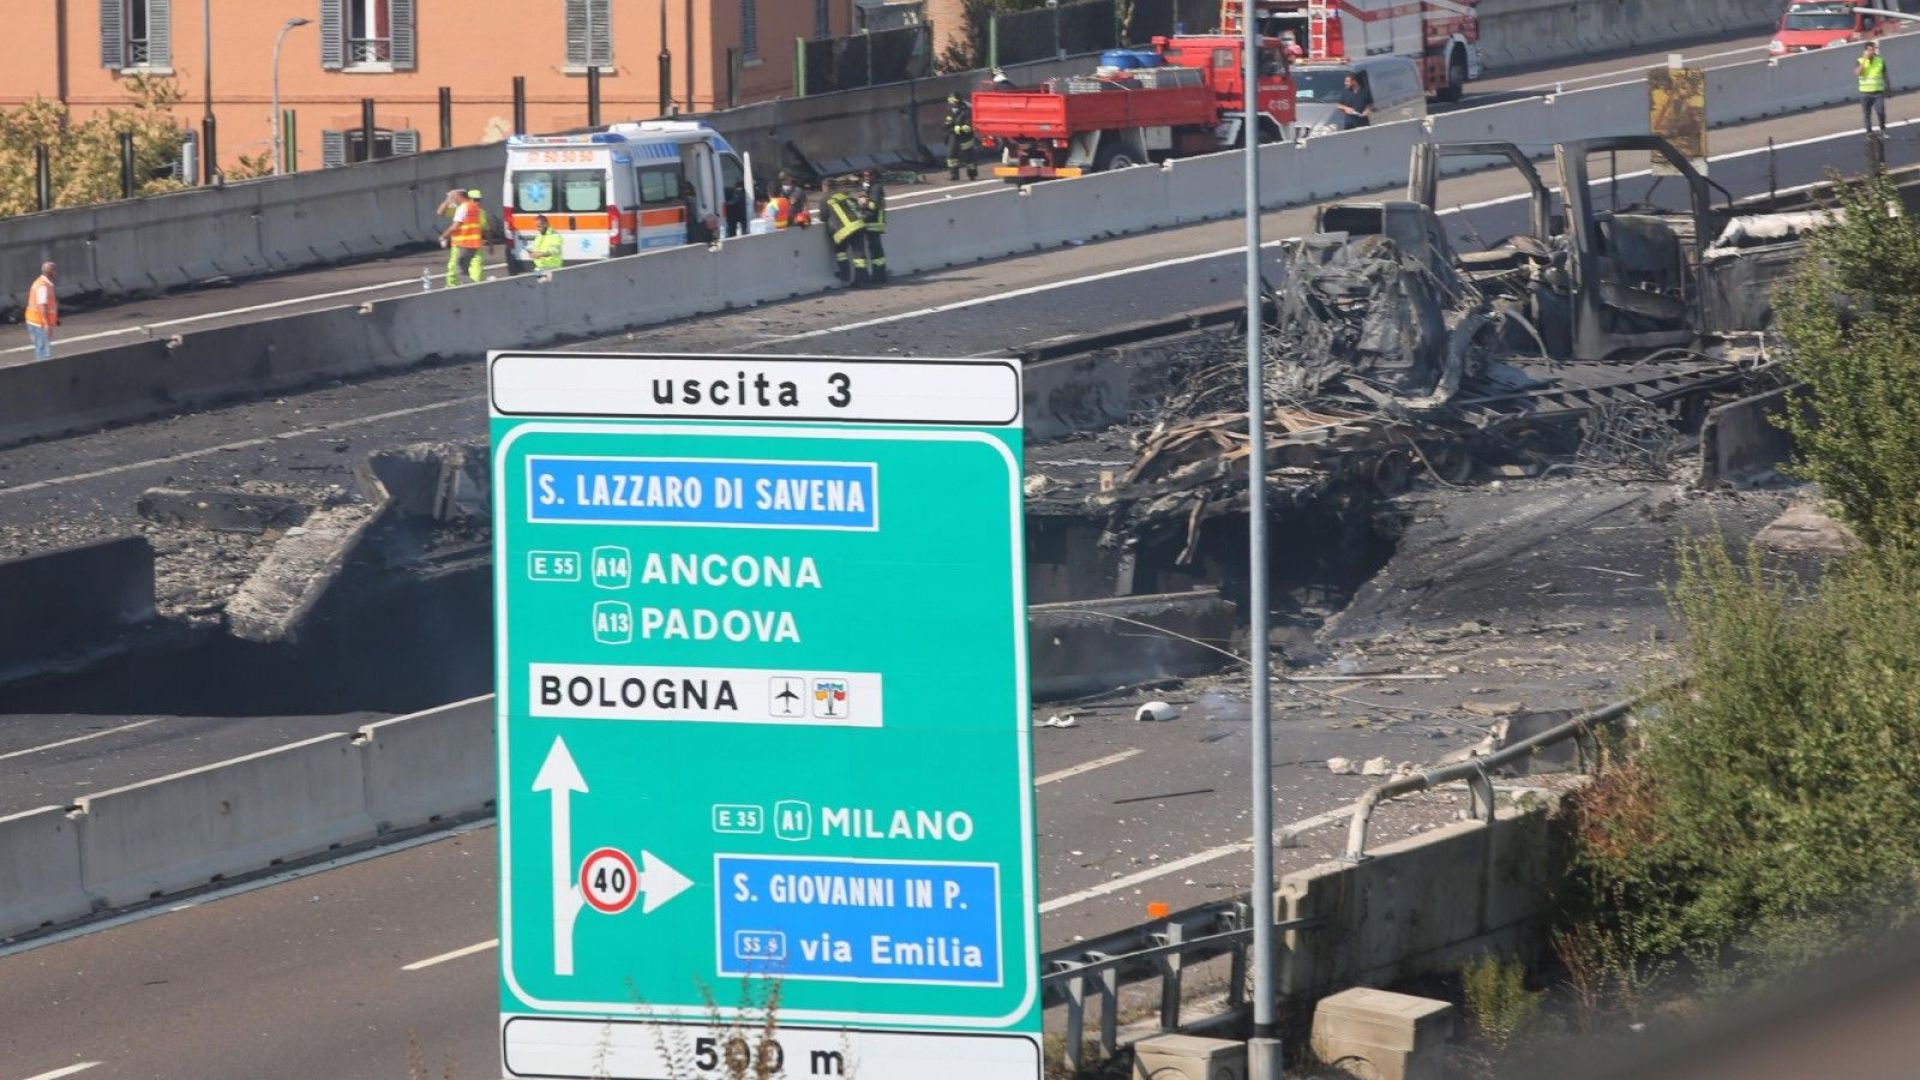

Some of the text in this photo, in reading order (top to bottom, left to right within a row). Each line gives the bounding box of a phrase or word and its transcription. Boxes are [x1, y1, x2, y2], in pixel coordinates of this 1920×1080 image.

[653, 371, 852, 408] uscita 3
[539, 473, 865, 512] S. LAZZARO DI SAVENA
[535, 552, 822, 589] E 55 A14 ANCONA
[597, 607, 800, 643] A13 PADOVA
[541, 676, 738, 710] BOLOGNA
[719, 806, 973, 842] E 35 A1 MILANO
[594, 867, 626, 894] 40
[734, 873, 968, 910] S. GIOVANNI IN P.
[743, 937, 761, 952] SS
[799, 932, 853, 963] via
[871, 935, 983, 968] Emilia
[695, 1037, 845, 1076] 500 m
